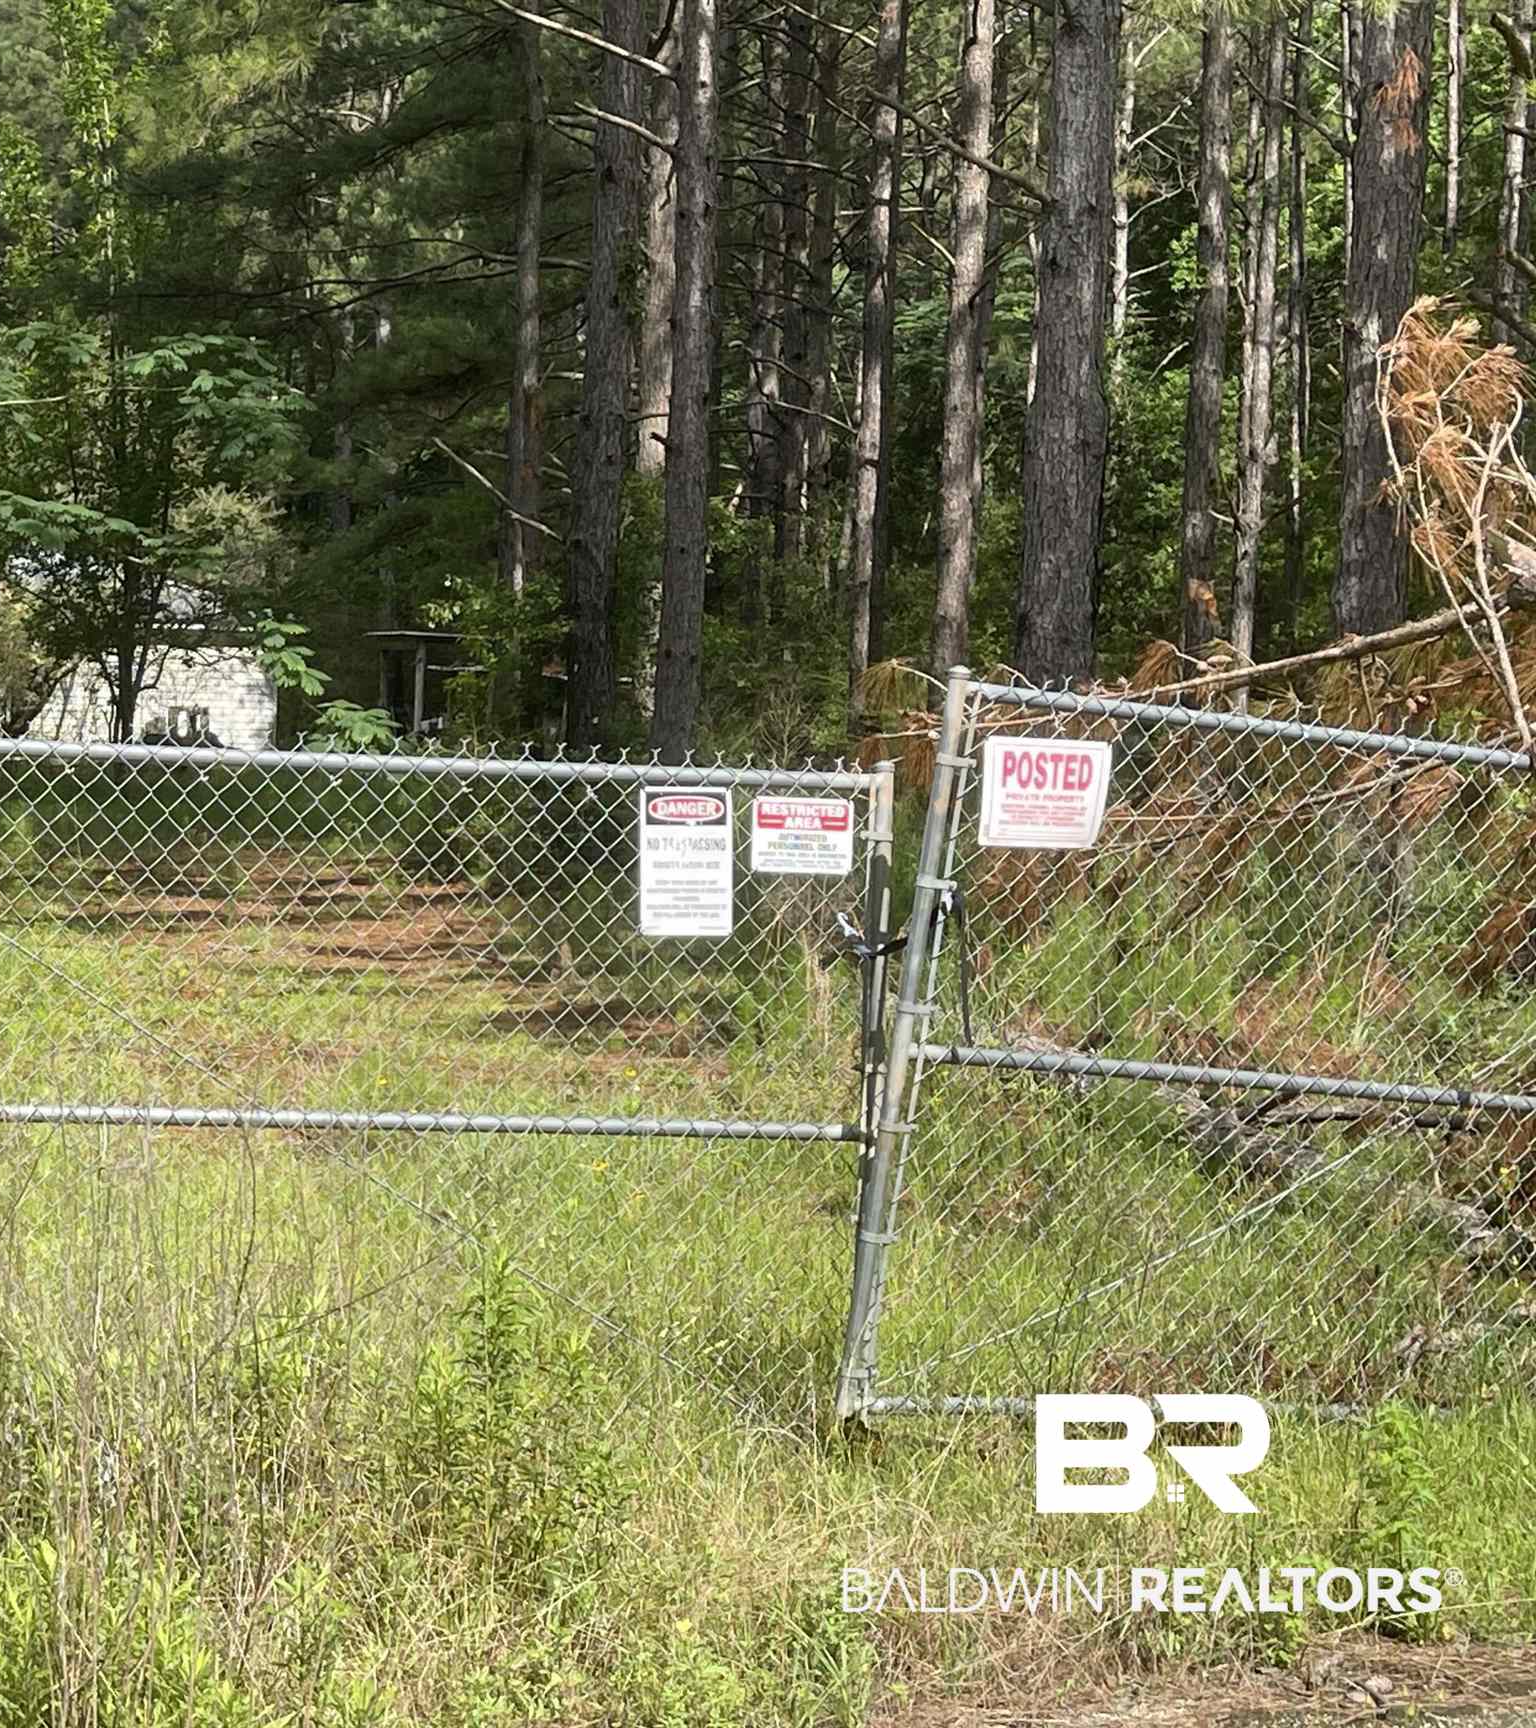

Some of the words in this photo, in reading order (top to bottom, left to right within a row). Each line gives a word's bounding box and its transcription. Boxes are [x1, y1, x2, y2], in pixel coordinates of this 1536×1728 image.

[1002, 751, 1093, 790] POSTED
[657, 801, 717, 816] DANGER
[761, 803, 846, 818] RESTRICTED
[784, 817, 822, 830] AREA
[647, 837, 660, 851] NO
